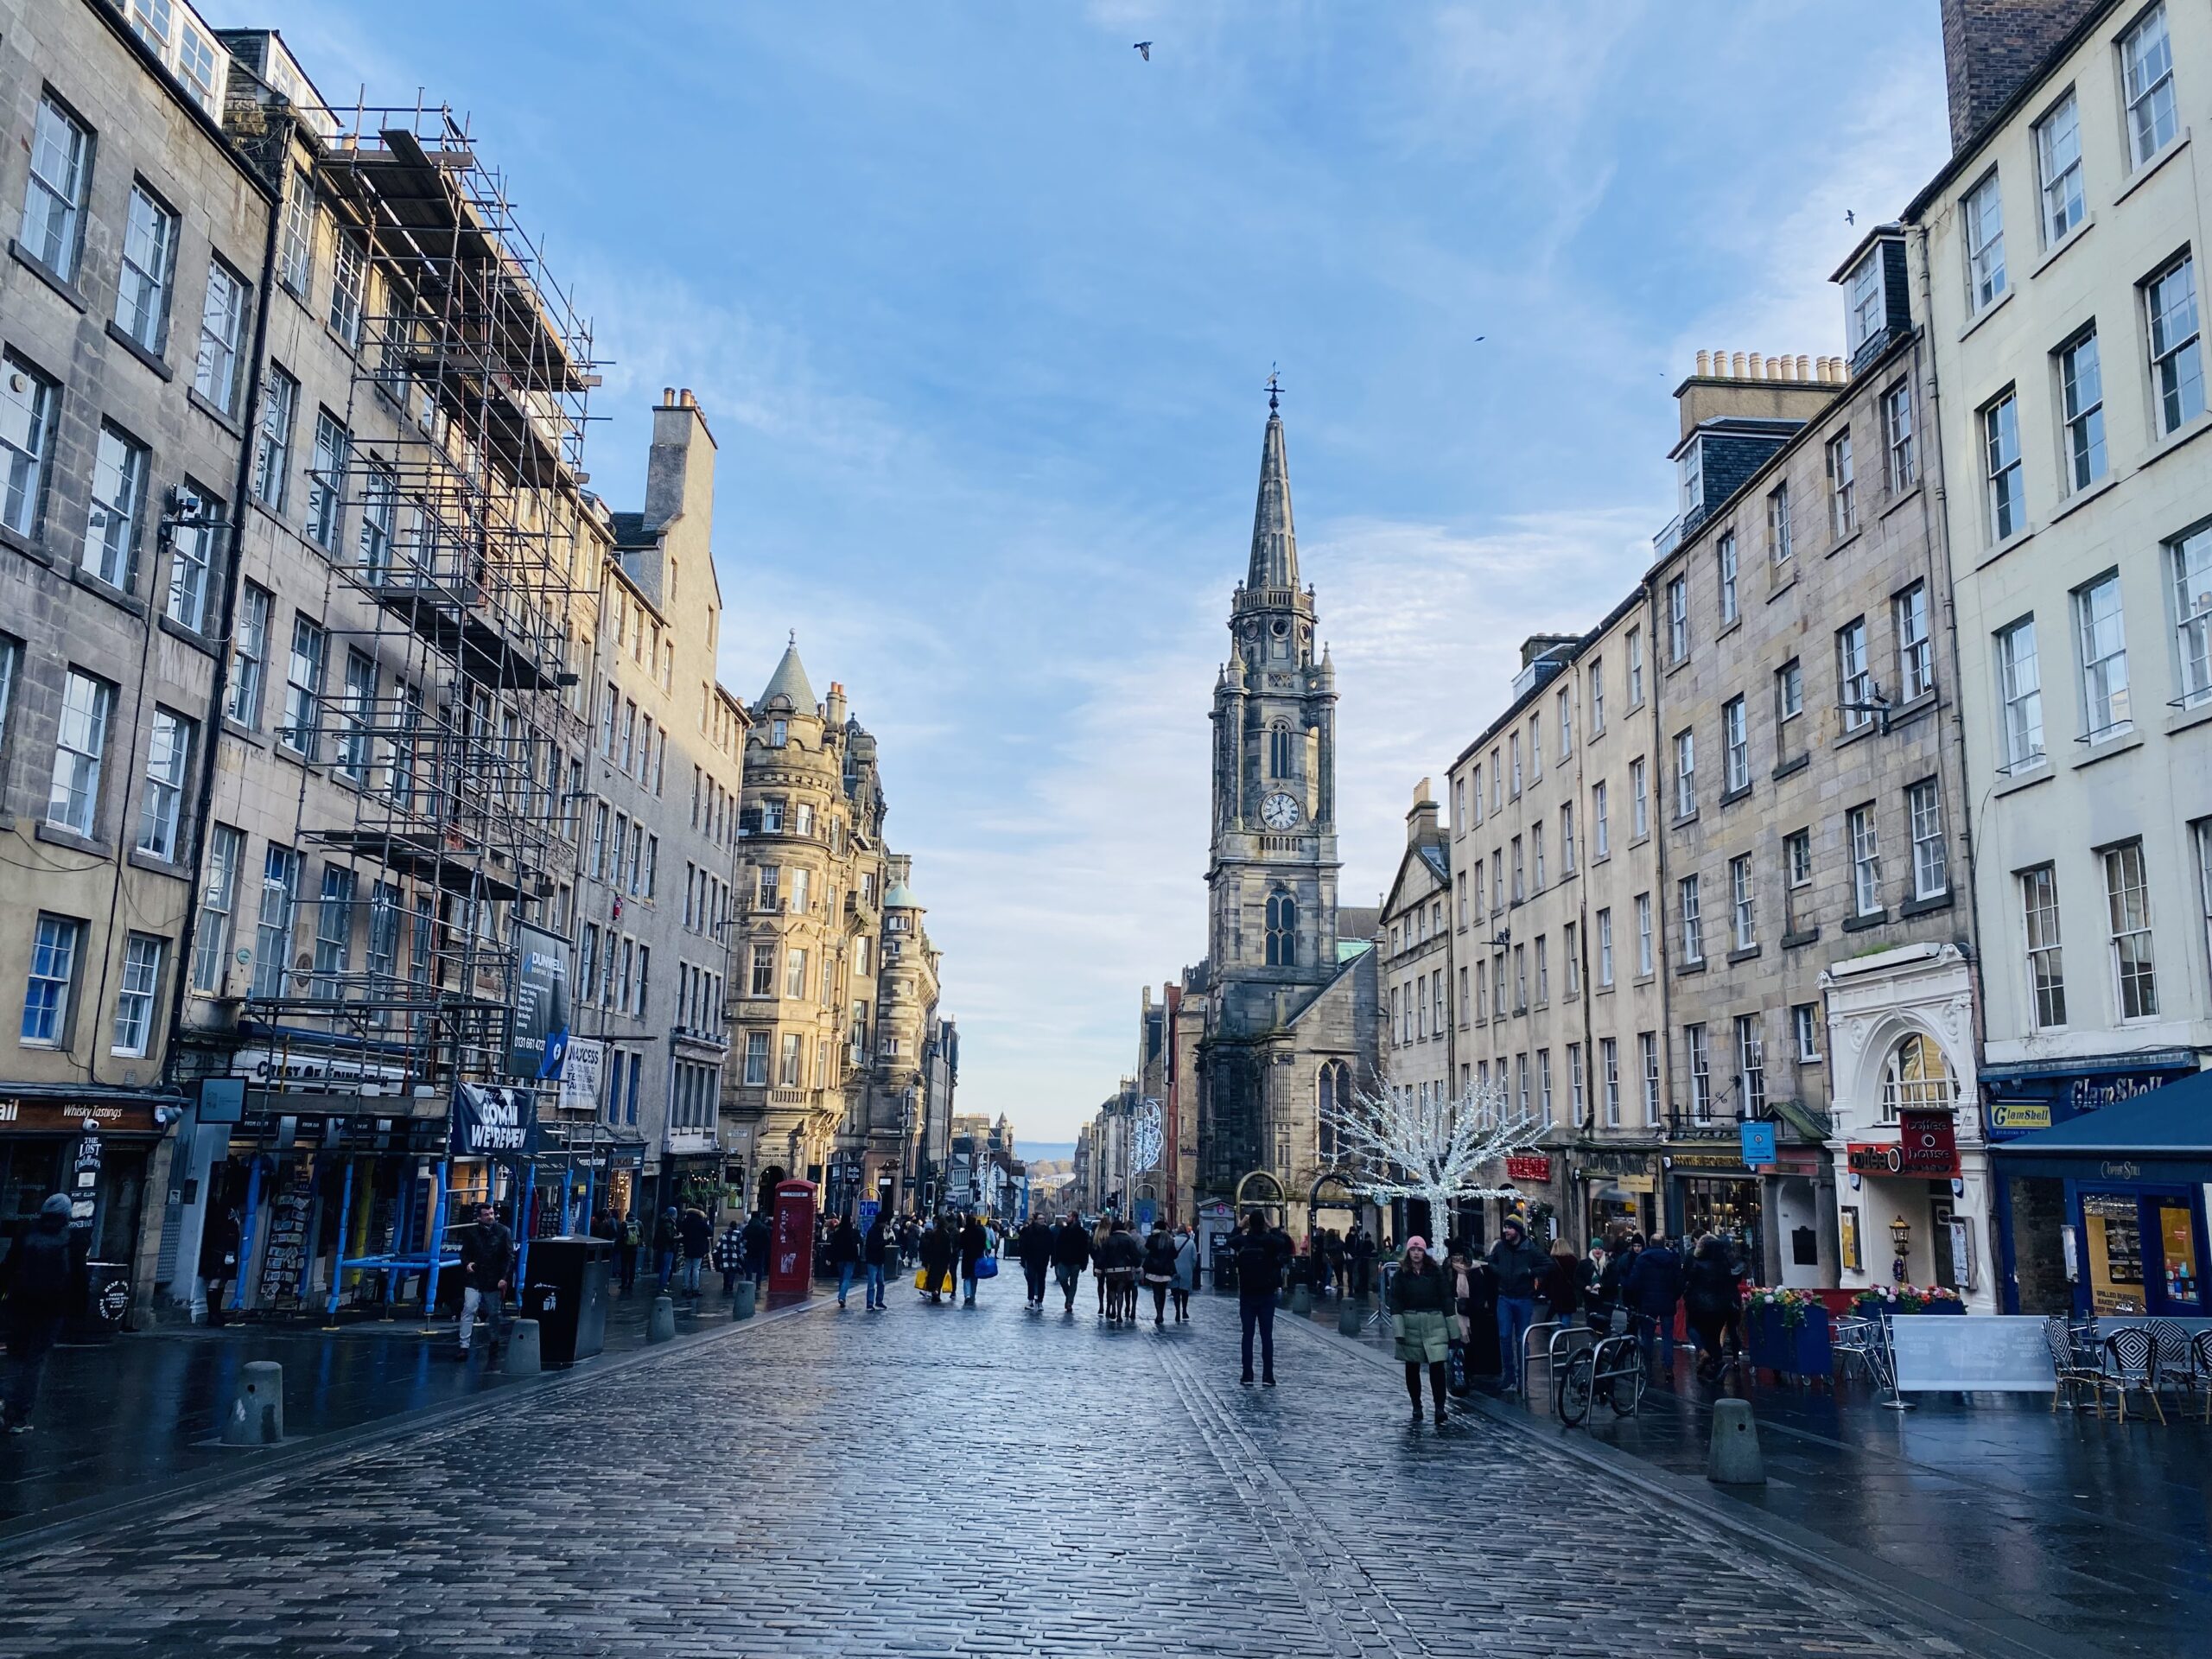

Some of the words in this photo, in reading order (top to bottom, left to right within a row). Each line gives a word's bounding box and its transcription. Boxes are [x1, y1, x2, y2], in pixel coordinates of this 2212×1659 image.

[531, 951, 566, 974] DUNWELL
[514, 1036, 526, 1049] 0131
[525, 1037, 535, 1051] 661
[63, 1103, 92, 1119] Whisky
[92, 1105, 123, 1122] Tastings
[79, 1143, 102, 1158] LOST
[1908, 1146, 1951, 1160] house
